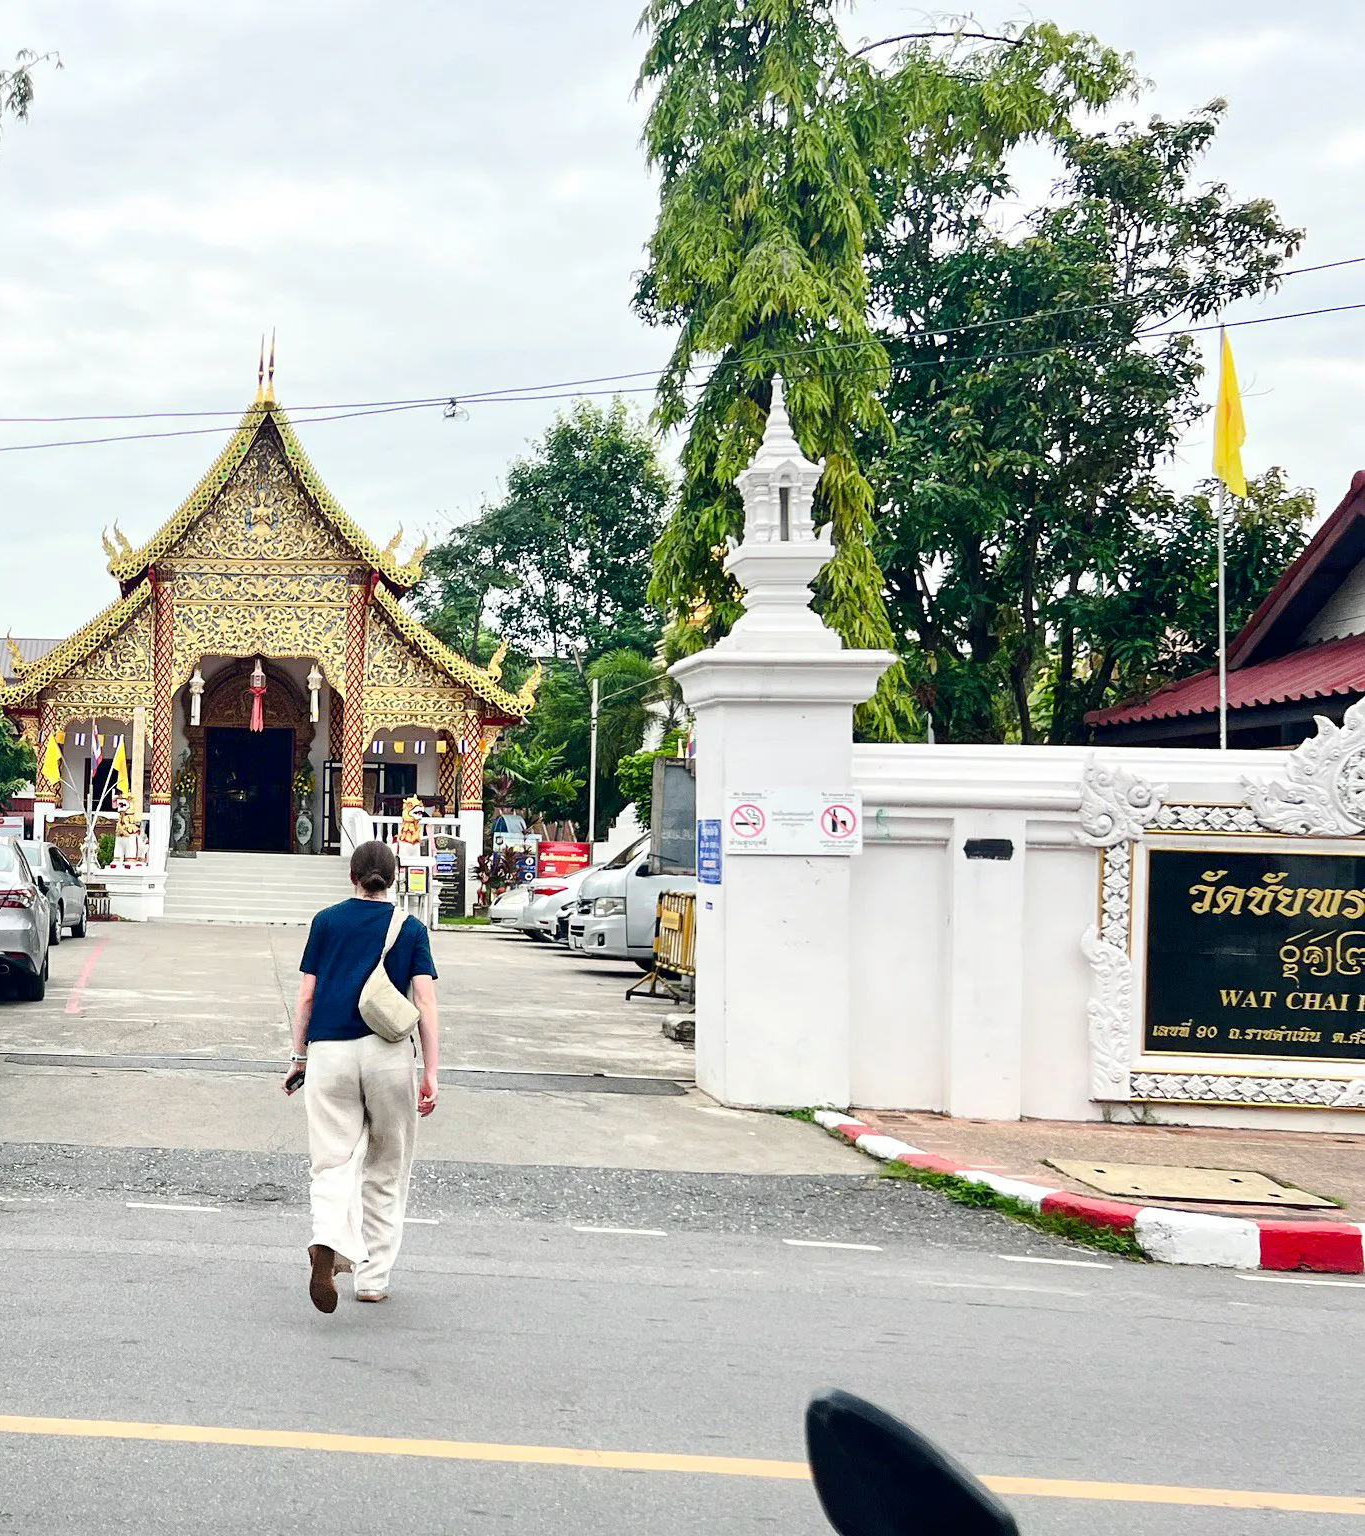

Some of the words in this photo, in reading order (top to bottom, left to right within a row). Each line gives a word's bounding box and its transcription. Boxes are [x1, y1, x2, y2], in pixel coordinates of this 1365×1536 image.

[1219, 989, 1277, 1009] WAT
[1285, 992, 1351, 1012] CHAI
[1152, 1018, 1193, 1038] เลขที่
